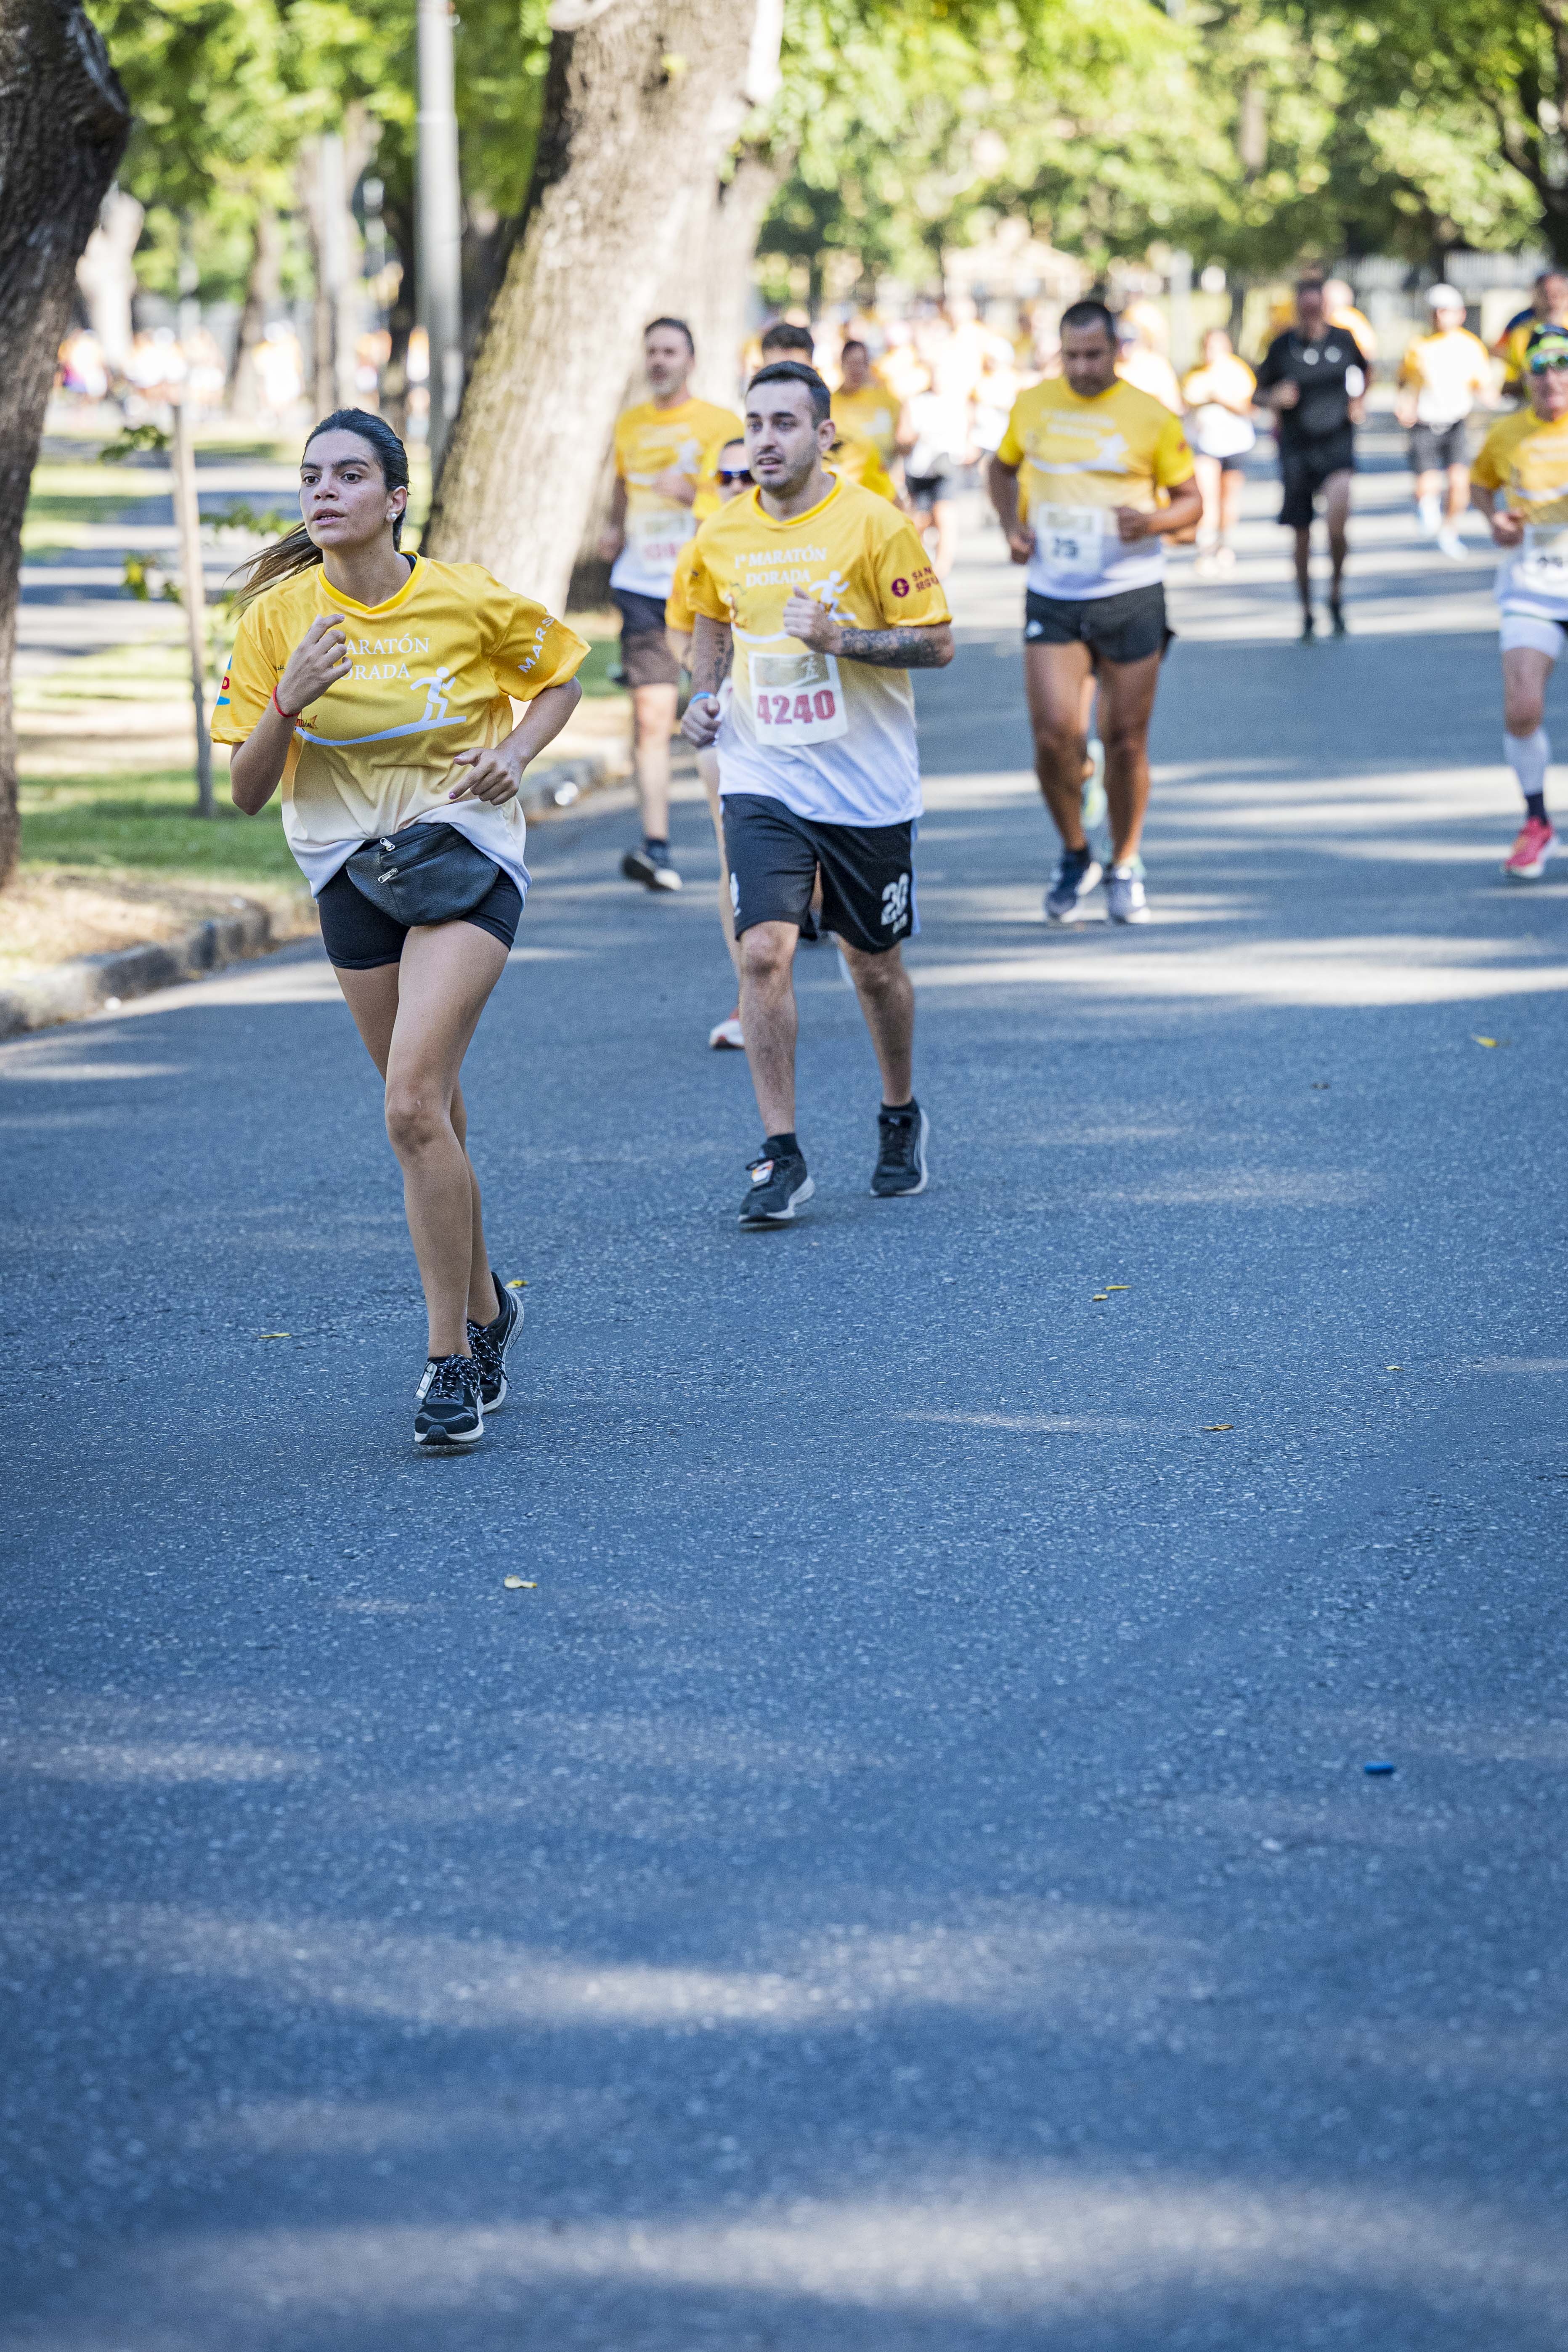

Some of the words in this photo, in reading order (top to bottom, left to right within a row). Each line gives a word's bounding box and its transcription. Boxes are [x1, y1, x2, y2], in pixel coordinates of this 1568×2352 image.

[748, 544, 828, 567] MARATÓN
[746, 568, 811, 588] DORADA
[327, 633, 430, 655] ARATÓN
[518, 610, 555, 673] MARS
[334, 662, 411, 680] ORADA
[757, 690, 836, 725] 4240
